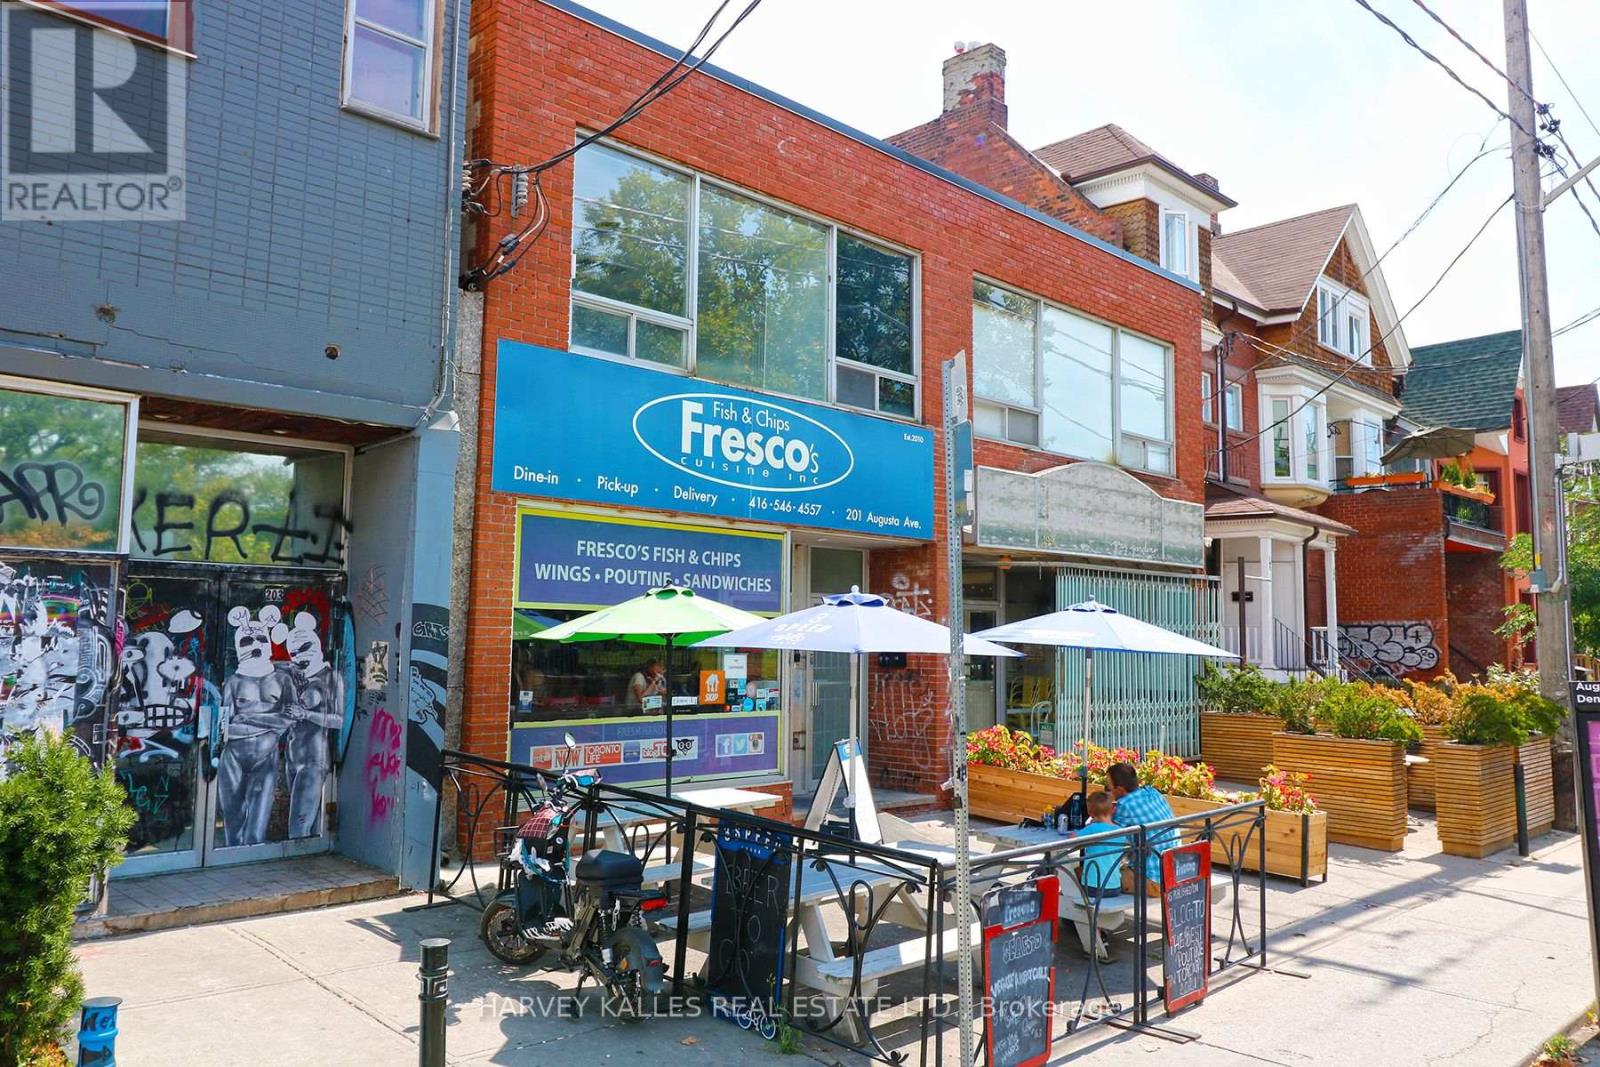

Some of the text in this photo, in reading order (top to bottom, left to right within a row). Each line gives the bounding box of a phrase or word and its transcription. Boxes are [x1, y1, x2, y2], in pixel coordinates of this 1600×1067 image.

[713, 401, 790, 434] Fish & Chips
[681, 400, 819, 474] Fresco's
[513, 465, 559, 485] Dine-in
[597, 475, 639, 497] Pick-up
[673, 485, 718, 507] Delivery
[846, 508, 862, 522] 201
[867, 513, 900, 528] Augusta
[903, 516, 922, 529] Ave.
[577, 540, 741, 567] FRESCO'S FISH & CHIPS
[534, 563, 772, 593] WINGS POUTINE SANDWICHES
[584, 742, 620, 757] TORONTO
[585, 754, 600, 764] LIFE
